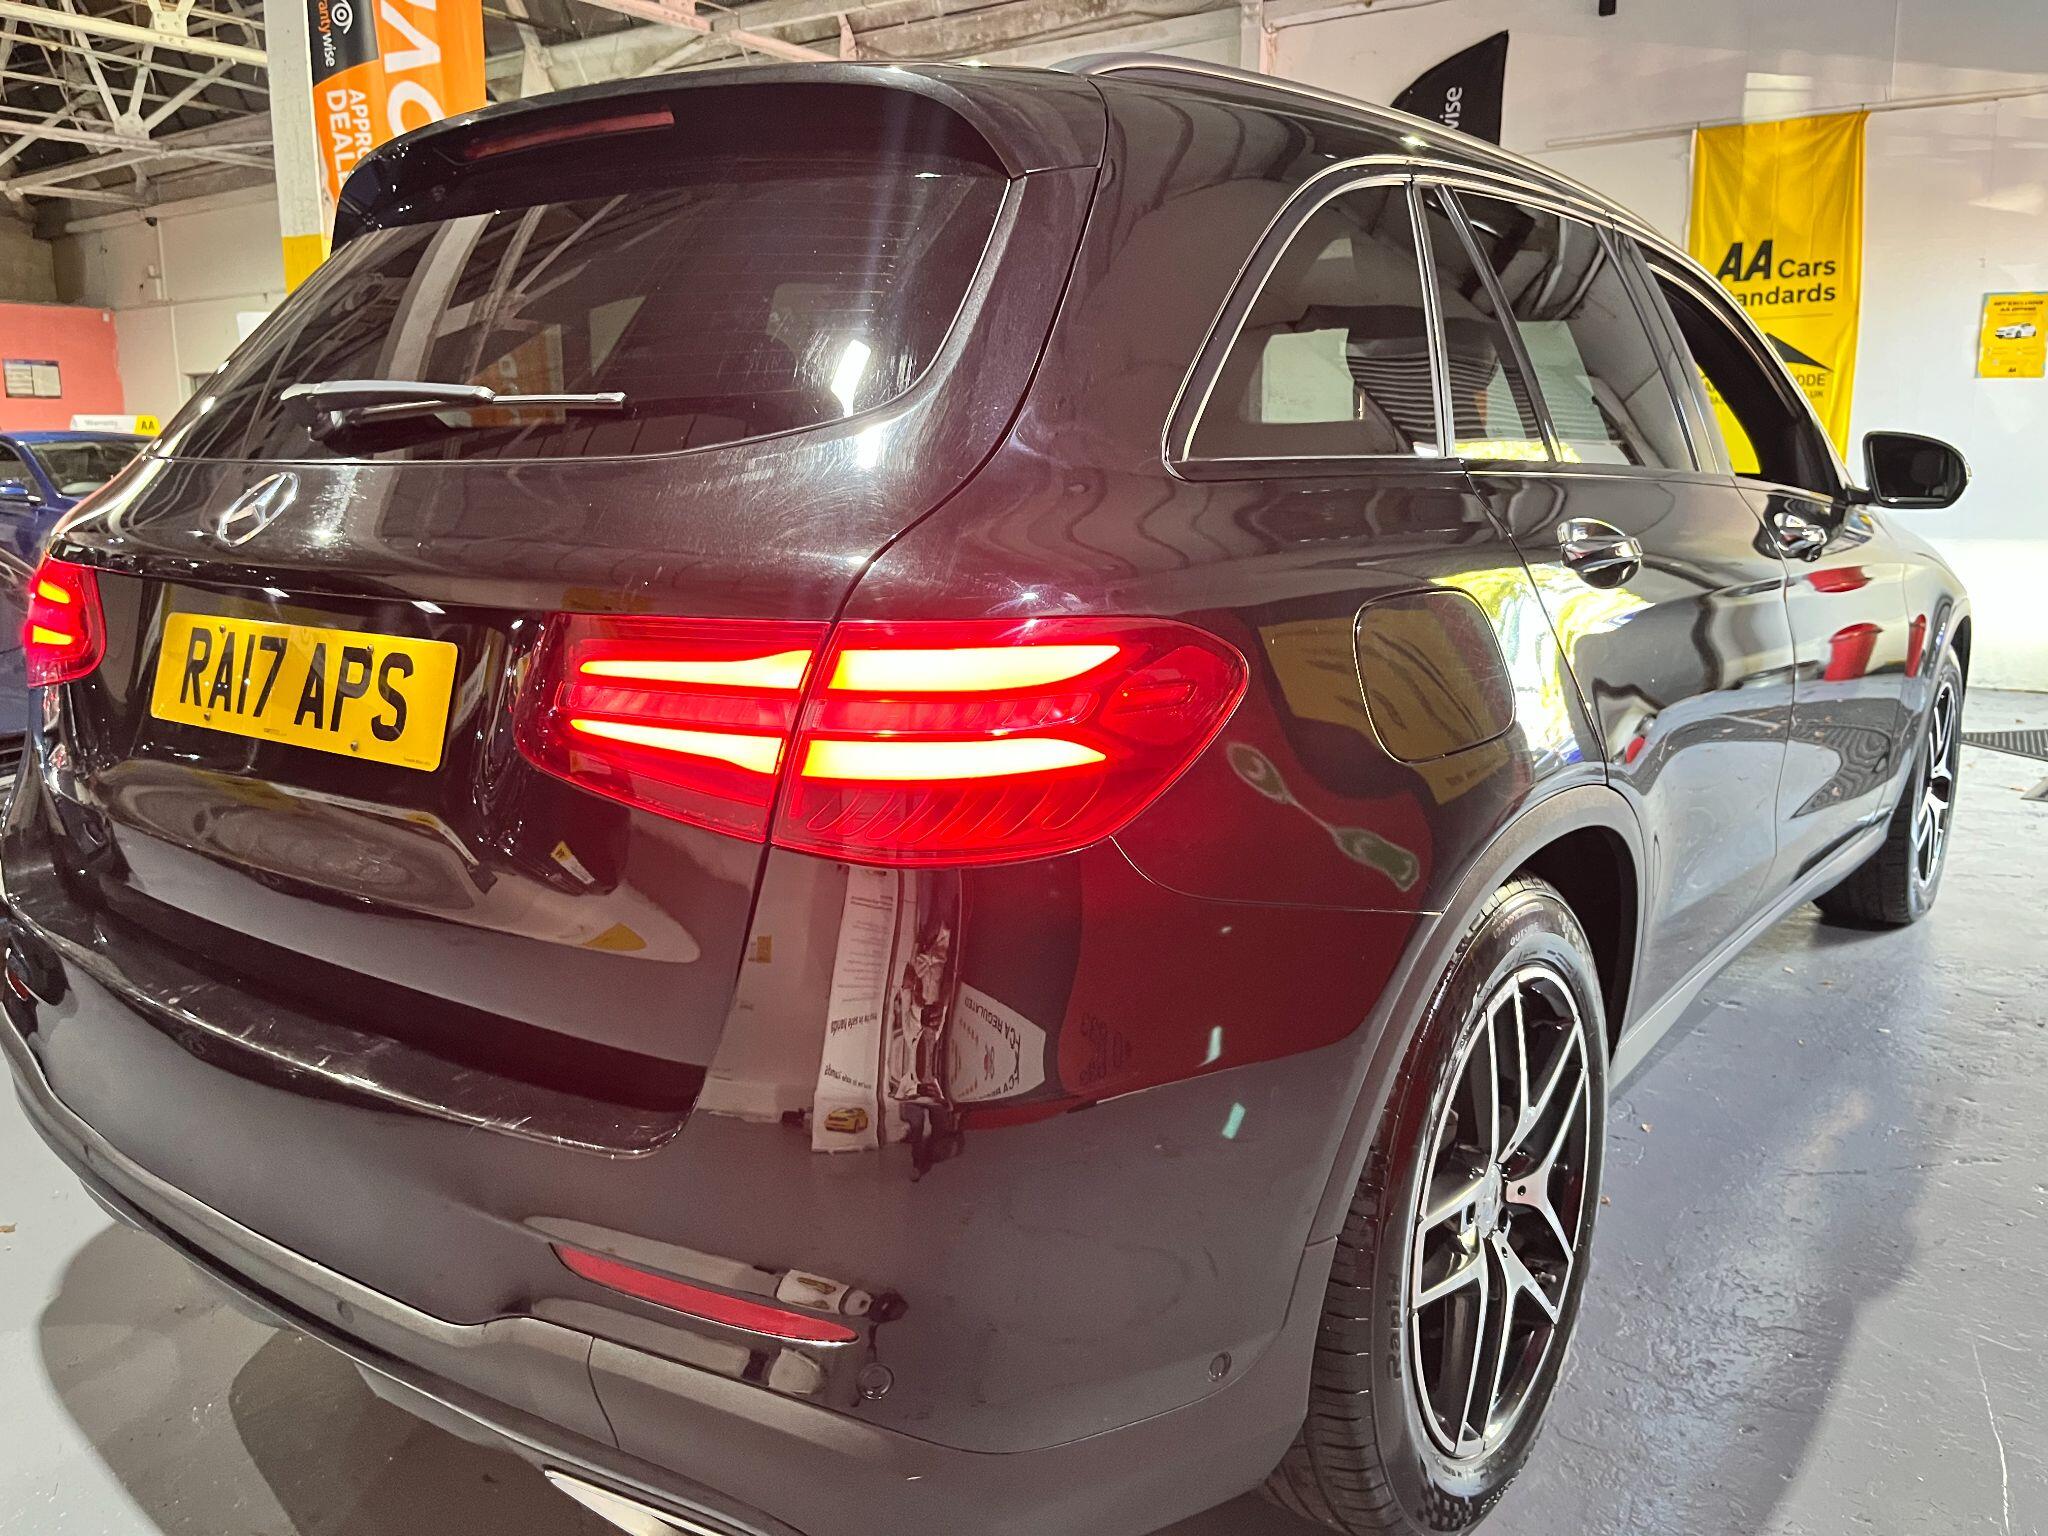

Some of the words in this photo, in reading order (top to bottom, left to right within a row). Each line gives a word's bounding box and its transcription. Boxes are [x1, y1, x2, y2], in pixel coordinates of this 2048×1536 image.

[1716, 239, 1773, 282] AA
[1778, 258, 1836, 279] Cars
[1733, 283, 1836, 306] andards
[141, 420, 155, 431] AA
[179, 627, 288, 718] RA17
[294, 642, 414, 742] APS
